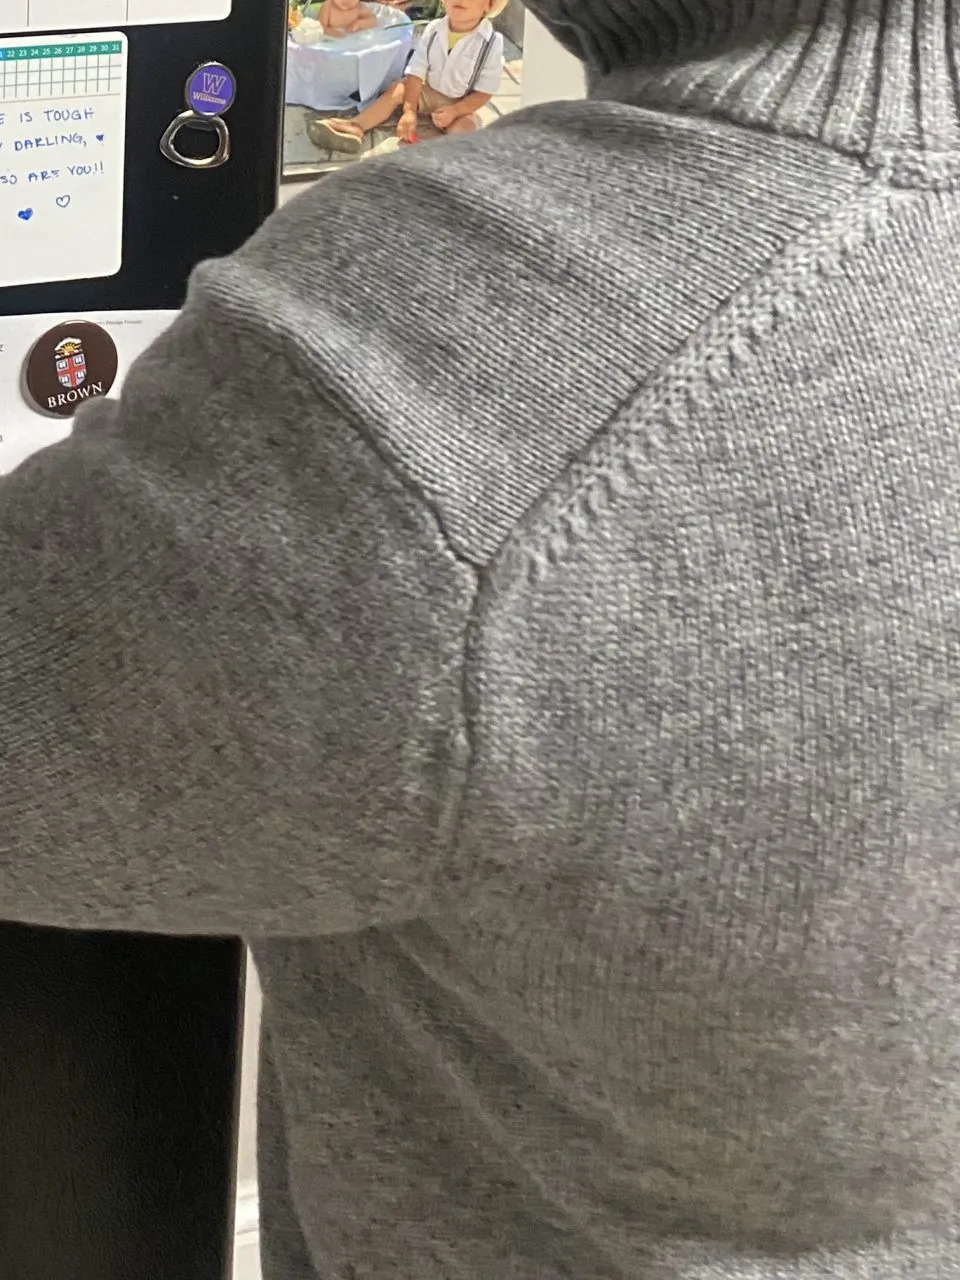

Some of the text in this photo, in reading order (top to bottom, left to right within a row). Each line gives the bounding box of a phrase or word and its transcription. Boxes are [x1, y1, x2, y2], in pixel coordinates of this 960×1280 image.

[203, 73, 226, 95] W
[20, 112, 32, 122] IS
[45, 108, 94, 121] TOUGH
[0, 175, 17, 185] SO
[28, 170, 59, 182] ARE
[48, 381, 103, 408] BROWN
